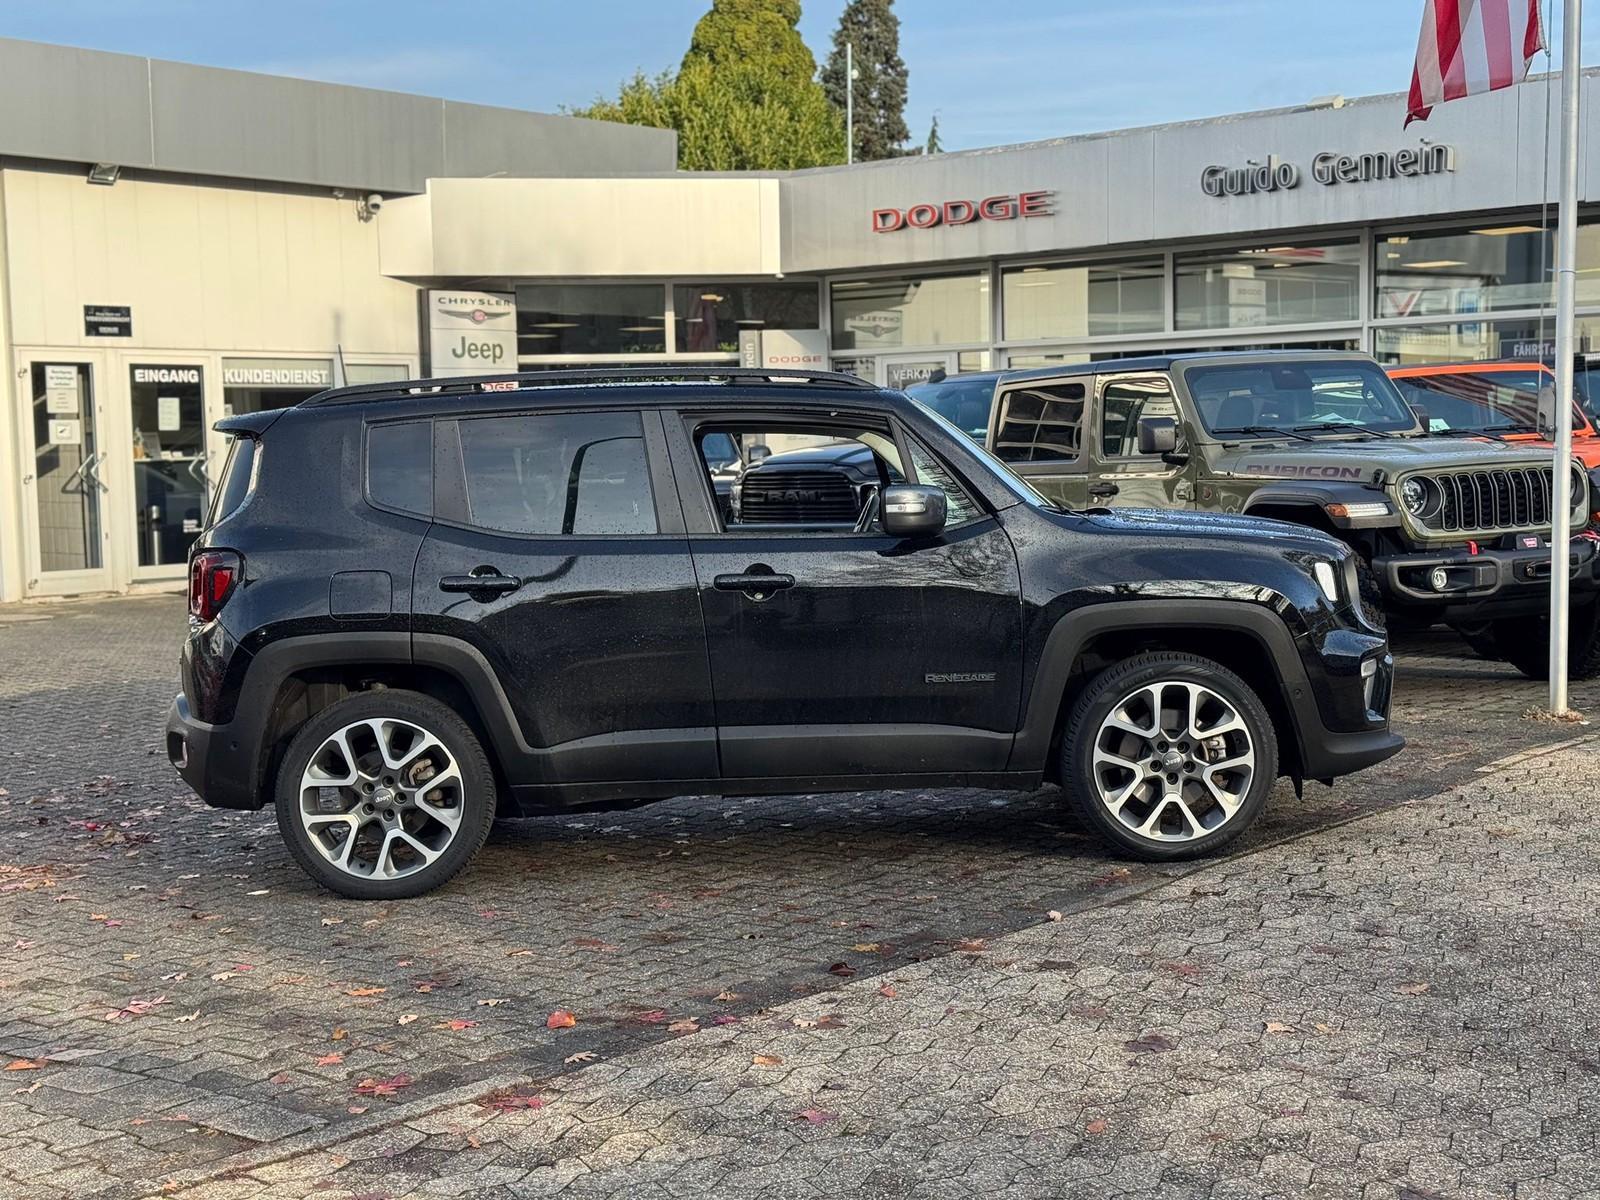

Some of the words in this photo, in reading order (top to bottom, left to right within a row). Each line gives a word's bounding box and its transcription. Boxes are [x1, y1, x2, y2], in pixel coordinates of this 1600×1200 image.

[1200, 154, 1303, 197] Guido
[1311, 138, 1456, 185] Gemein
[872, 190, 1056, 233] DODGE
[438, 297, 511, 307] CHRYSLER
[452, 336, 504, 364] Jeep
[1513, 342, 1550, 357] FÄHRST
[768, 356, 822, 364] DODGE
[134, 369, 199, 383] EINGANG
[224, 369, 329, 384] KUNDENDIENST
[1247, 464, 1362, 478] RUBICON
[925, 673, 997, 683] RENEGADE
